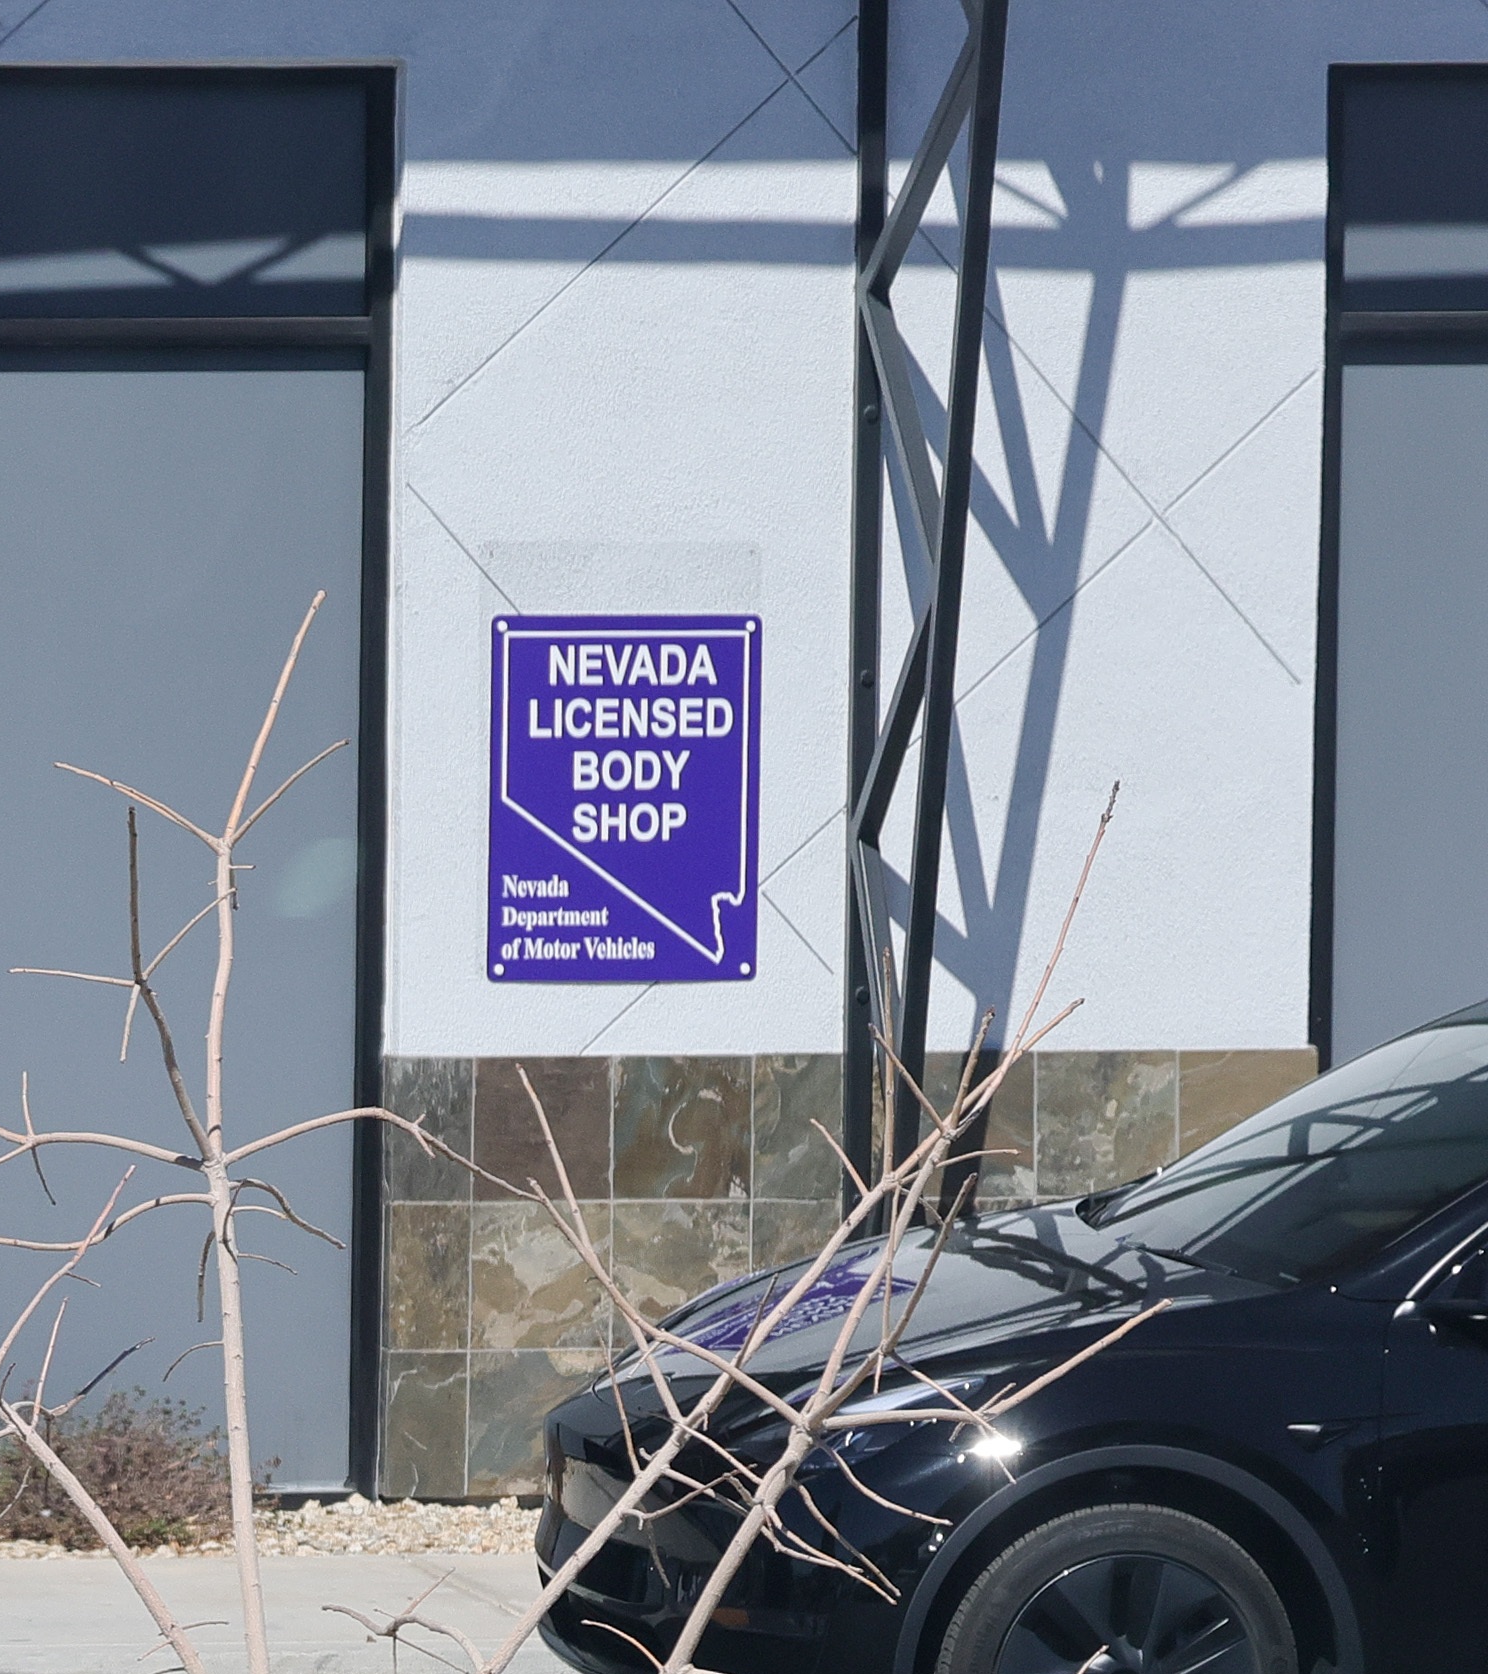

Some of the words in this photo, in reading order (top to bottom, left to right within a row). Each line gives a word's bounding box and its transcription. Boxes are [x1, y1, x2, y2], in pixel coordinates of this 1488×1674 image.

[547, 643, 718, 687] NEVADA
[527, 696, 734, 739] LICENSED
[572, 749, 691, 791] BODY
[571, 802, 688, 843] SHOP
[501, 874, 569, 898] Nevada
[501, 905, 610, 931] Department
[501, 938, 521, 960] of
[523, 938, 581, 960] Motor
[584, 936, 655, 960] Vehicles
